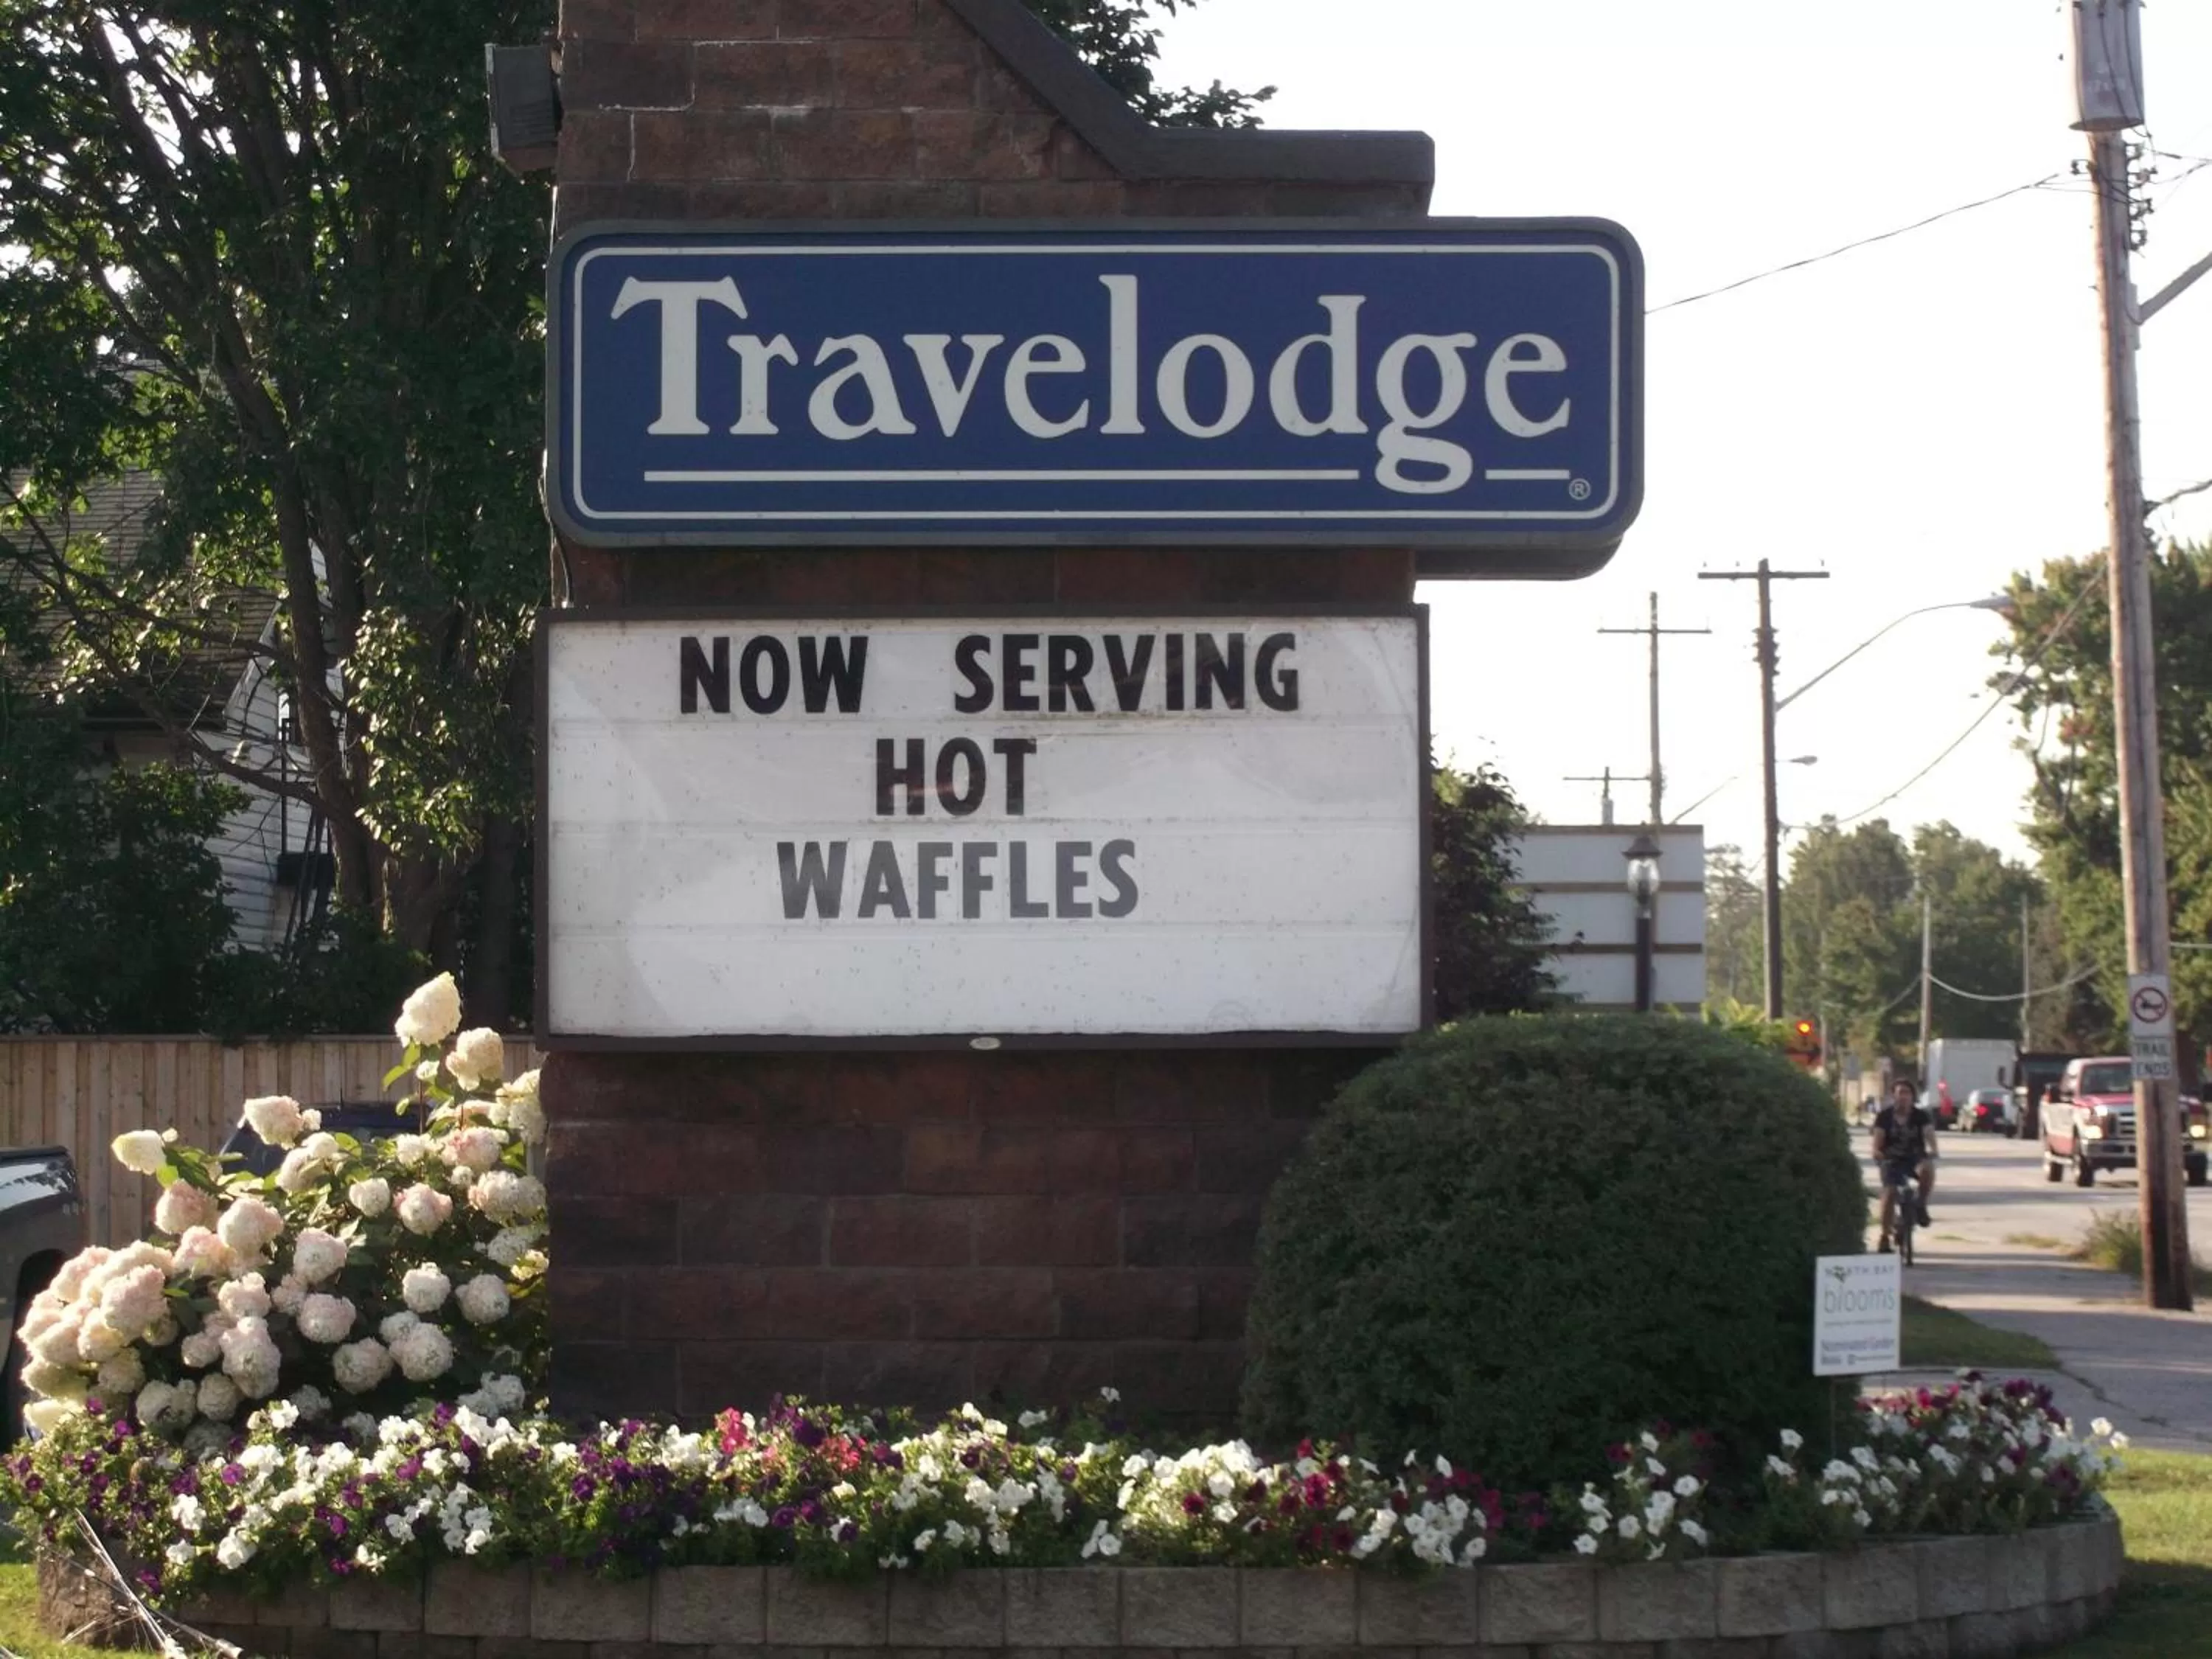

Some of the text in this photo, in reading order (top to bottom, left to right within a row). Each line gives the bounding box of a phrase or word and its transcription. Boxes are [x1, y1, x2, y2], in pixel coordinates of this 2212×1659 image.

[611, 274, 1570, 494] Travelodge
[680, 632, 1299, 714] NOW SERVING
[875, 737, 1037, 816] HOT
[776, 839, 1139, 919] WAFFLES
[2134, 1042, 2168, 1056] TRAIL
[2135, 1061, 2171, 1076] ENDS
